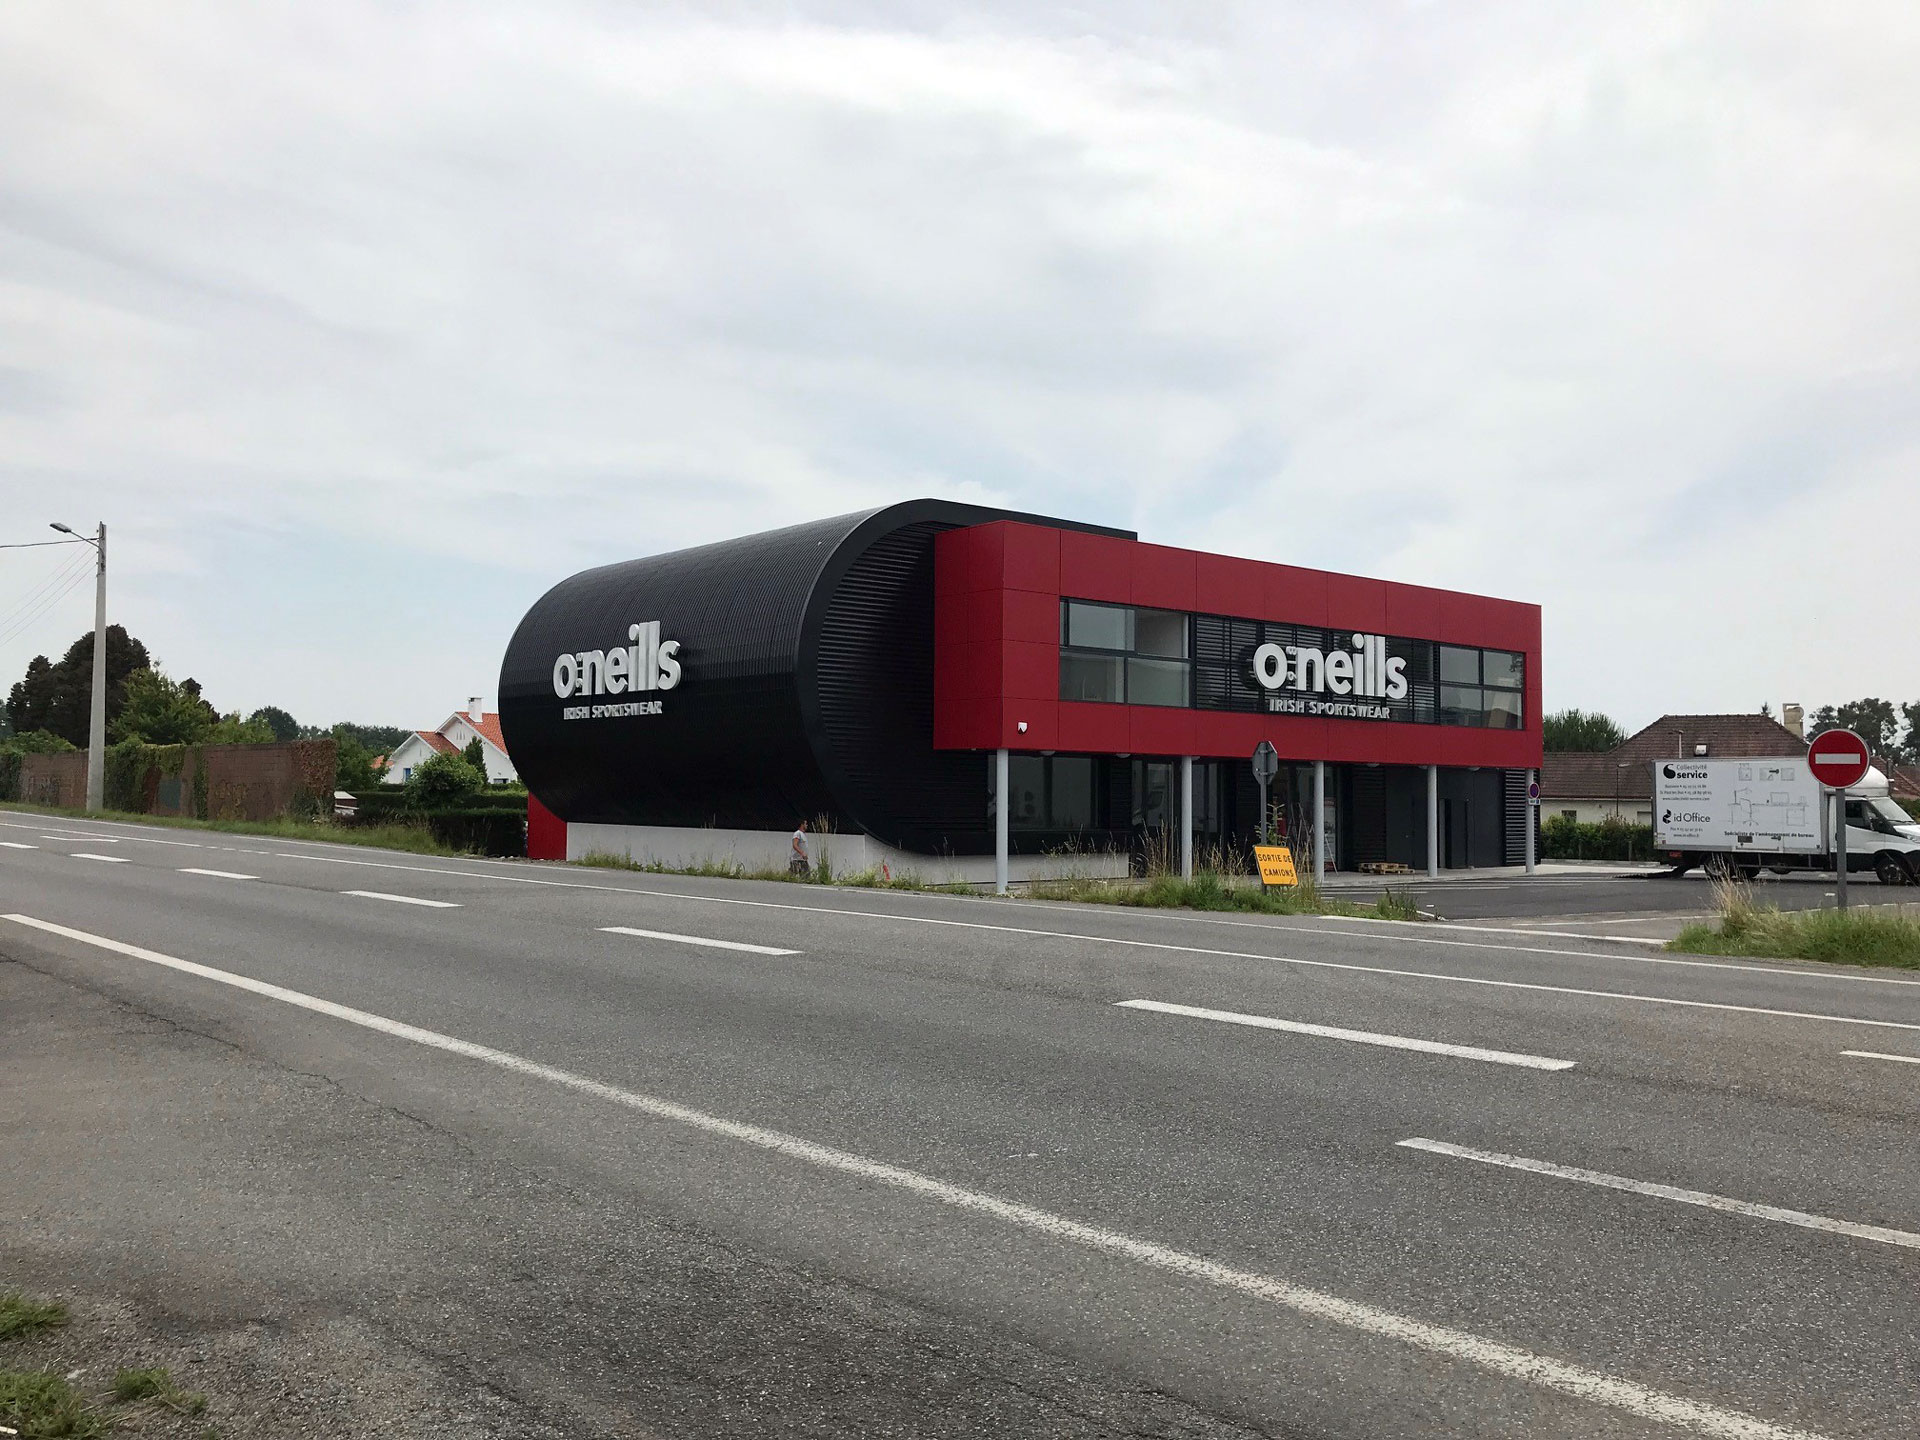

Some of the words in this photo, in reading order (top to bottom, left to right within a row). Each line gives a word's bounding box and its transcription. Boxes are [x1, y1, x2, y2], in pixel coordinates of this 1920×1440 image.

[564, 706, 590, 720] IRISH
[592, 701, 662, 718] SPORTSWEAR
[1269, 699, 1305, 713] IRISH
[1309, 701, 1390, 719] SPORTSWEAR
[1677, 770, 1708, 778] service
[1674, 813, 1682, 822] id
[1683, 813, 1711, 822] Office
[1258, 853, 1283, 862] SORTIE
[1283, 855, 1292, 863] DE
[1263, 869, 1294, 877] CAMIONS
